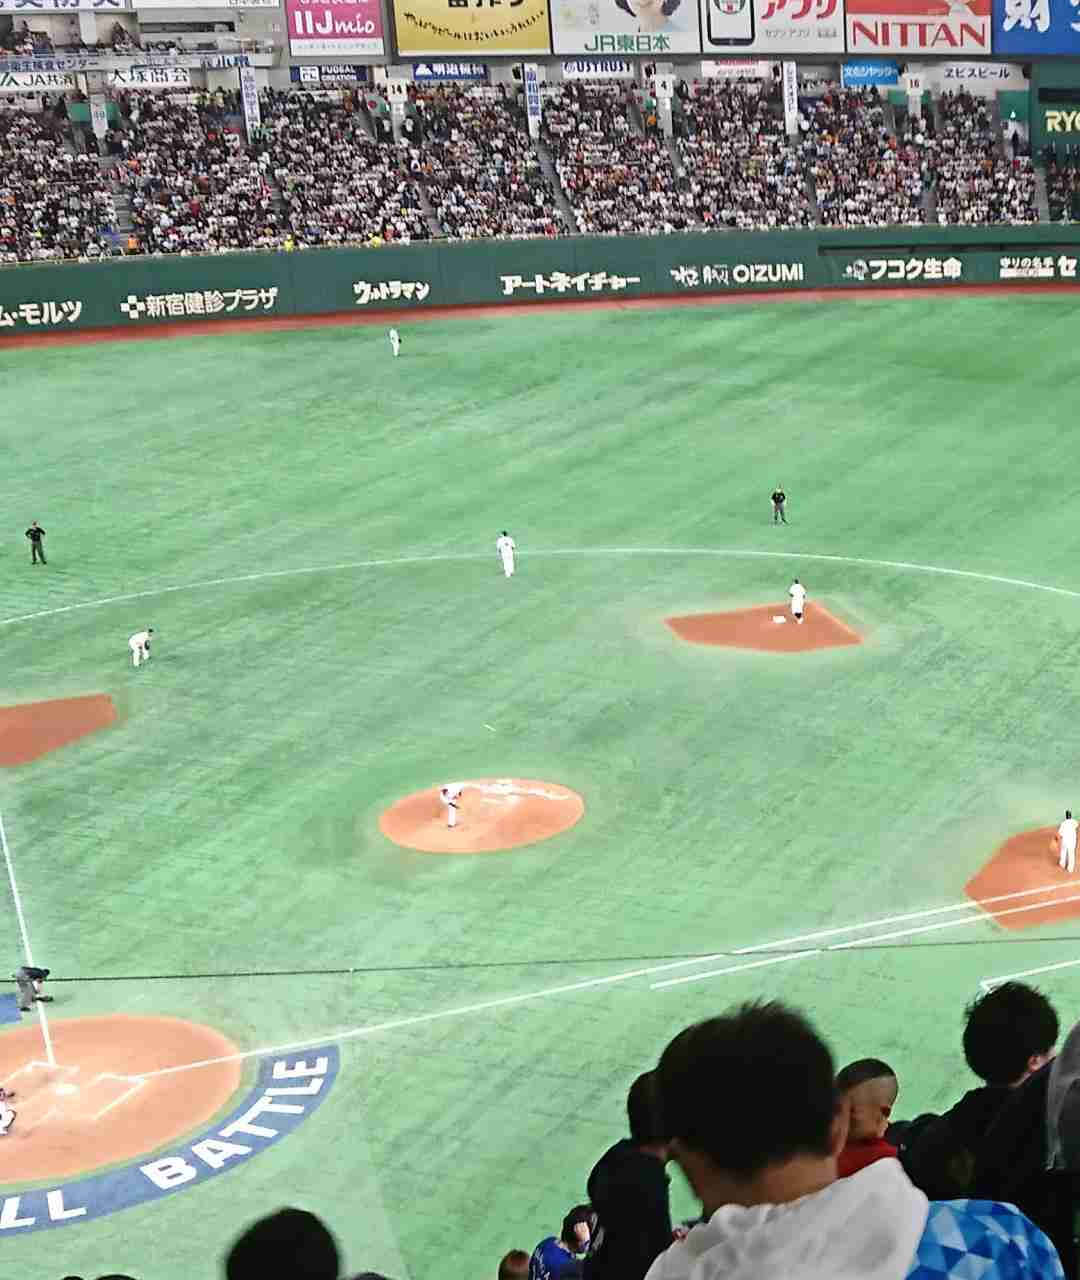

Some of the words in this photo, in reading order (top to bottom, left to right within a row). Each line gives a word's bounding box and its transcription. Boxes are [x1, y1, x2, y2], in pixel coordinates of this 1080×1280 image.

[584, 35, 671, 52] JR東日本
[851, 21, 986, 48] NITTAN
[909, 79, 920, 89] 16
[733, 263, 804, 283] OIZUMI
[869, 256, 962, 280] フコク生命
[500, 271, 641, 296] アートネイチャー
[146, 287, 278, 317] 新宿健診プラザ
[139, 1055, 329, 1190] BATTLE
